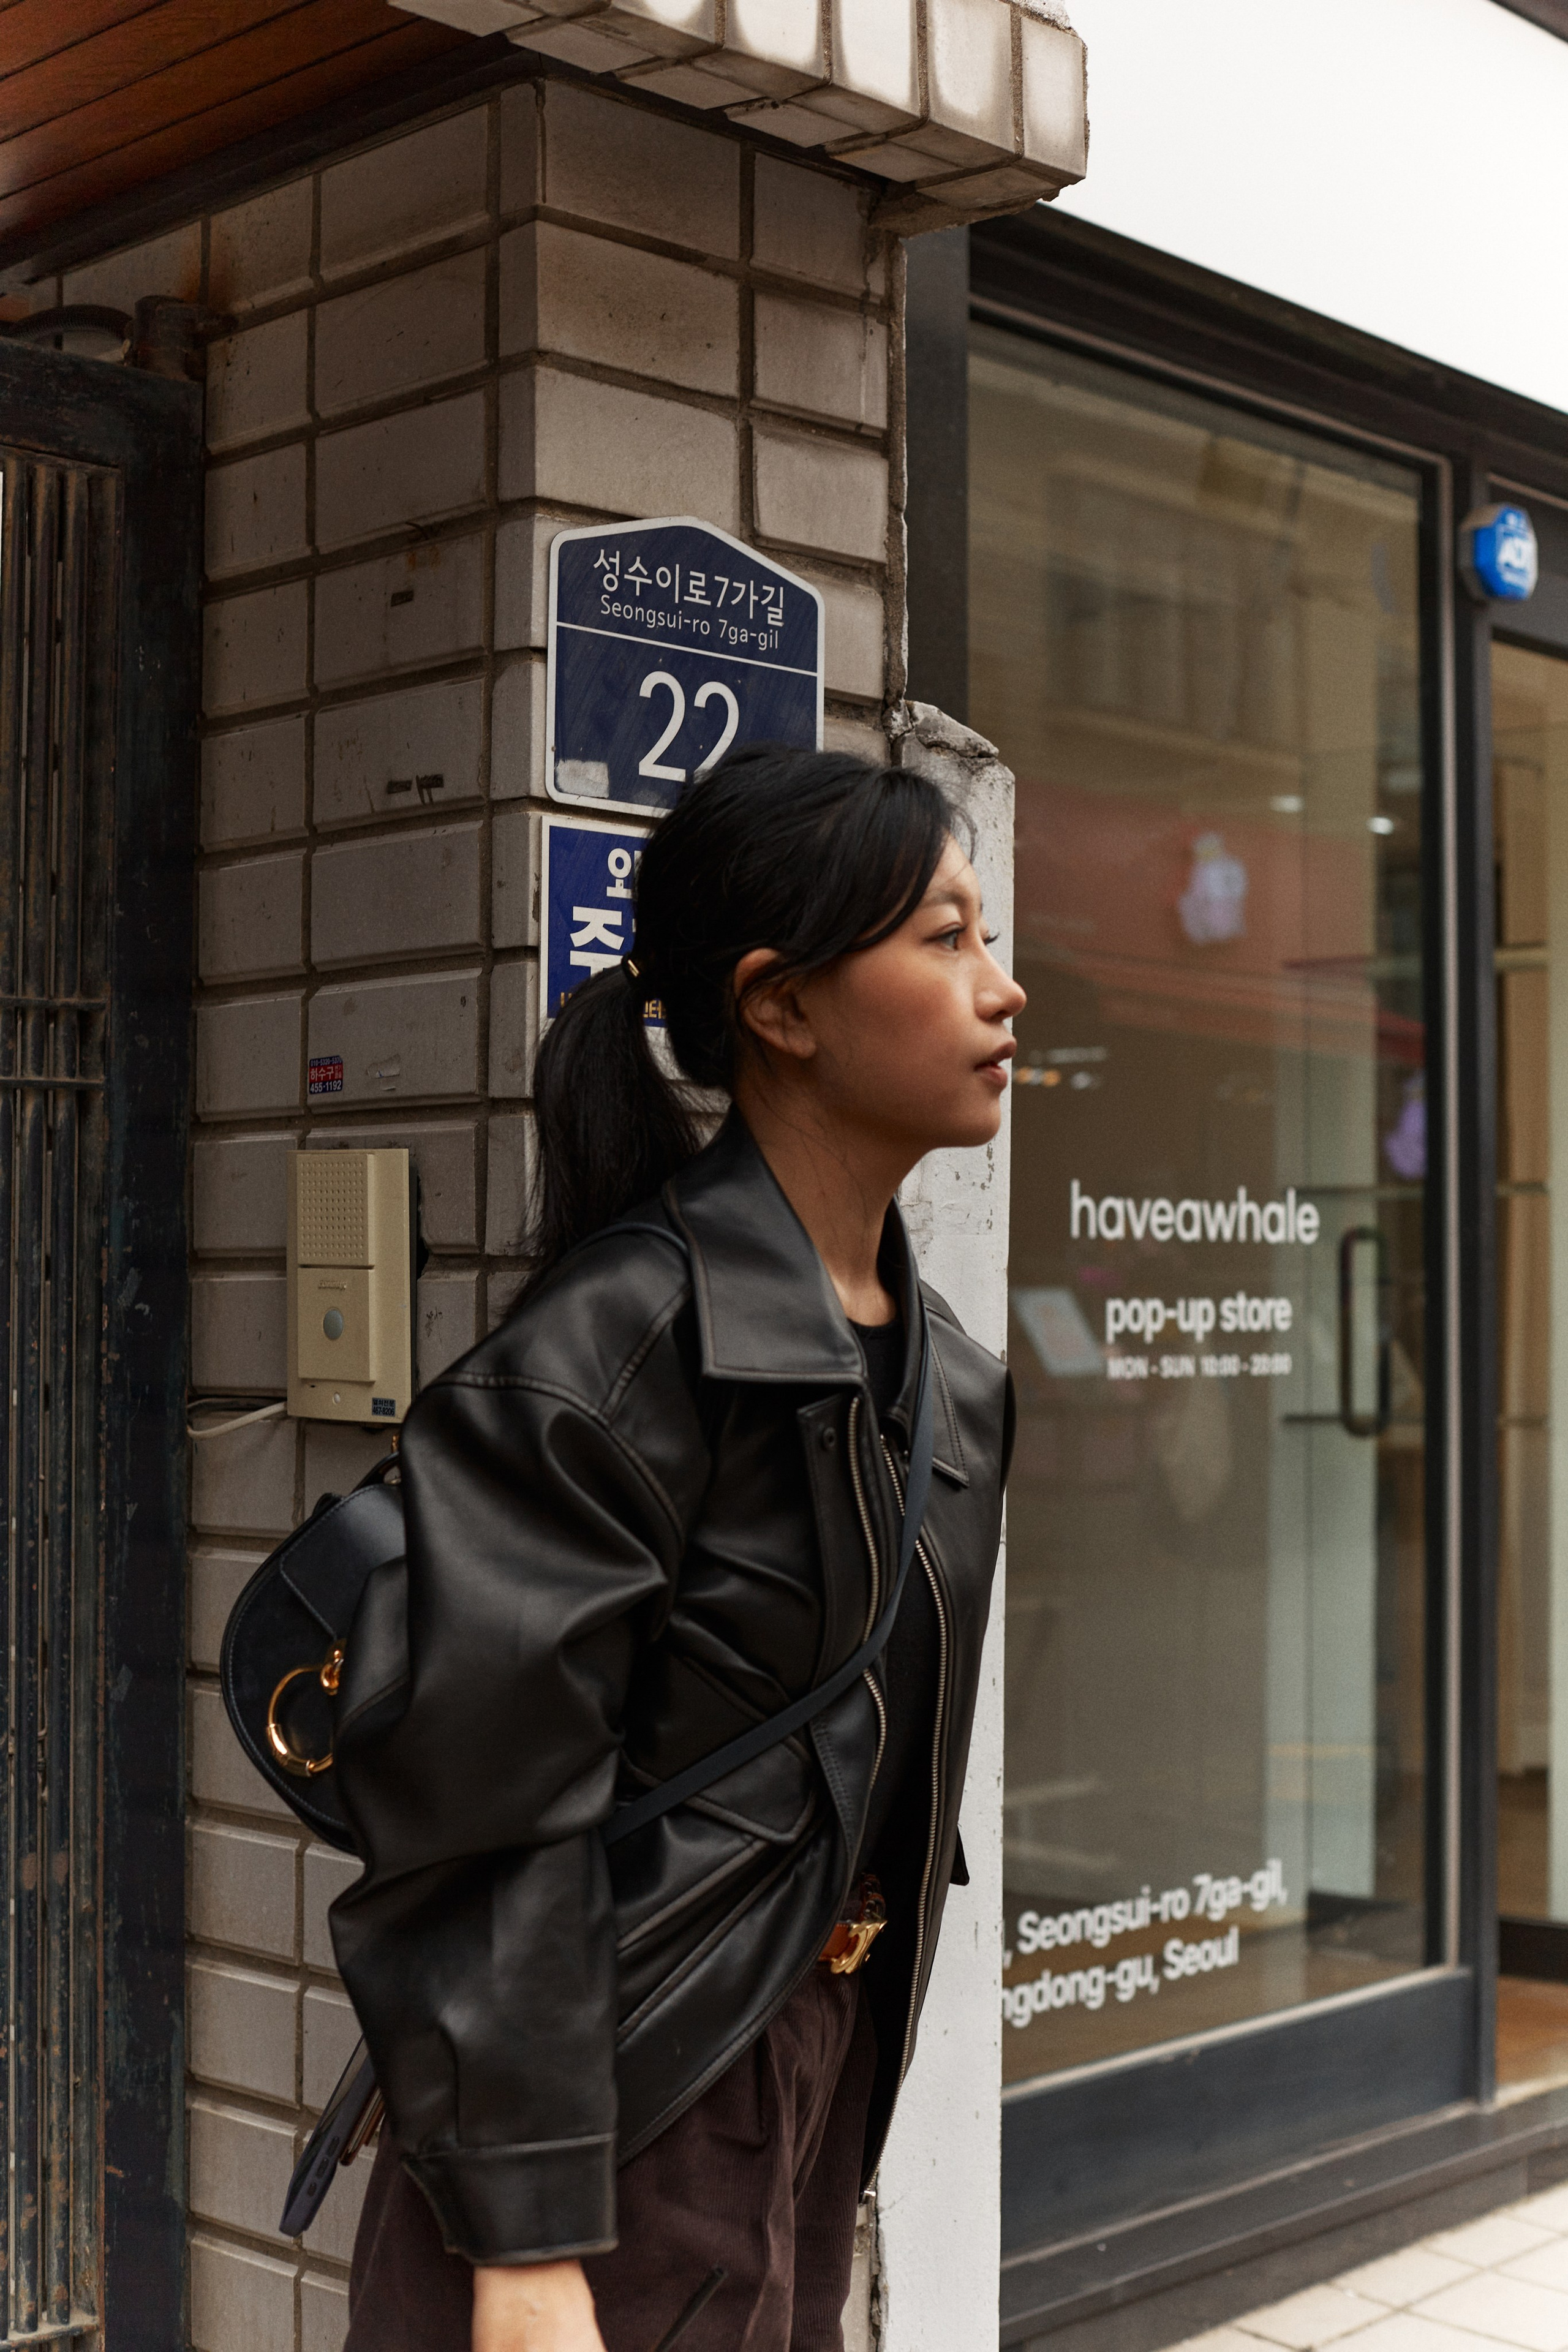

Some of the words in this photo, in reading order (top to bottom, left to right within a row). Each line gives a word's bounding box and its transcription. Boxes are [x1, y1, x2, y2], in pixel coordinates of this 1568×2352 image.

[593, 549, 785, 627] 성수이로7가길
[600, 594, 710, 635] Seongsui-ro
[718, 620, 779, 650] 7ga-gil
[639, 671, 739, 784] 22
[310, 1066, 334, 1082] 하수구
[1070, 1178, 1320, 1244] haveawhale
[1106, 1297, 1216, 1344] pop-up
[1219, 1291, 1292, 1332] store
[1017, 1885, 1190, 1954] Seongsui-ro
[1193, 1858, 1287, 1921] 7ga-gil,
[1163, 1925, 1240, 1980] Seoul
